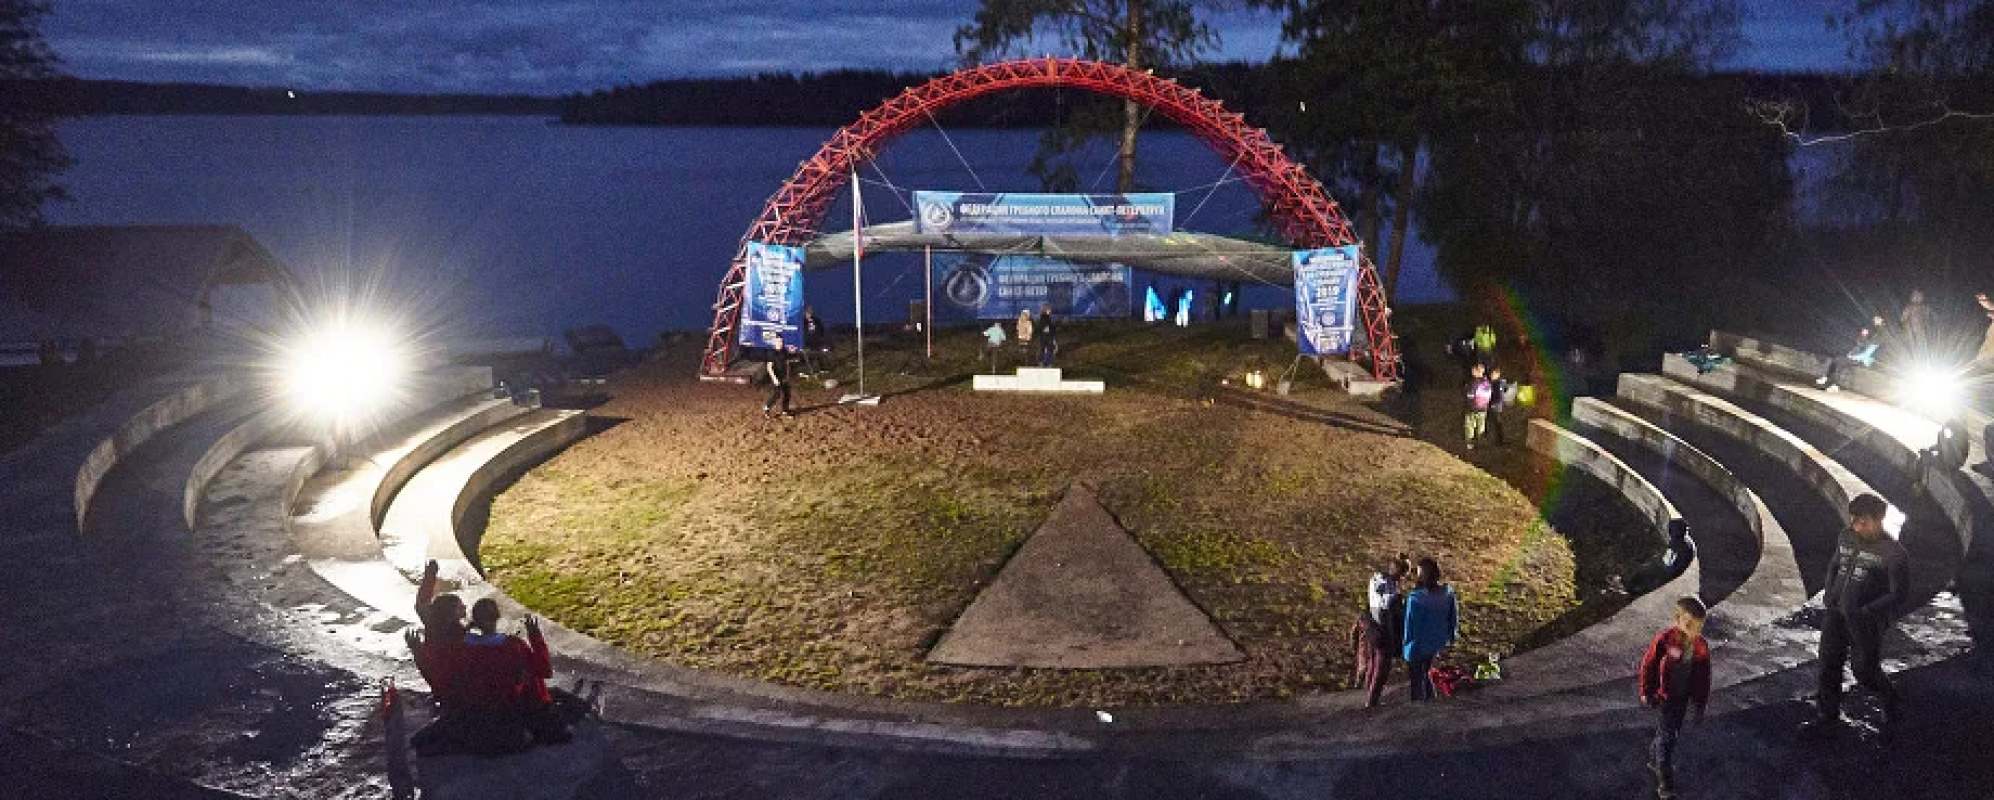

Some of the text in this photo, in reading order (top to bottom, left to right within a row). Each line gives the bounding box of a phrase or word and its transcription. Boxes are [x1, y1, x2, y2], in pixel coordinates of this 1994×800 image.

[960, 204, 1008, 215] ФЕДЕРАЦИЯ
[1009, 205, 1049, 216] ГРЕБНОГО
[1050, 205, 1088, 216] СЛАЛОМА
